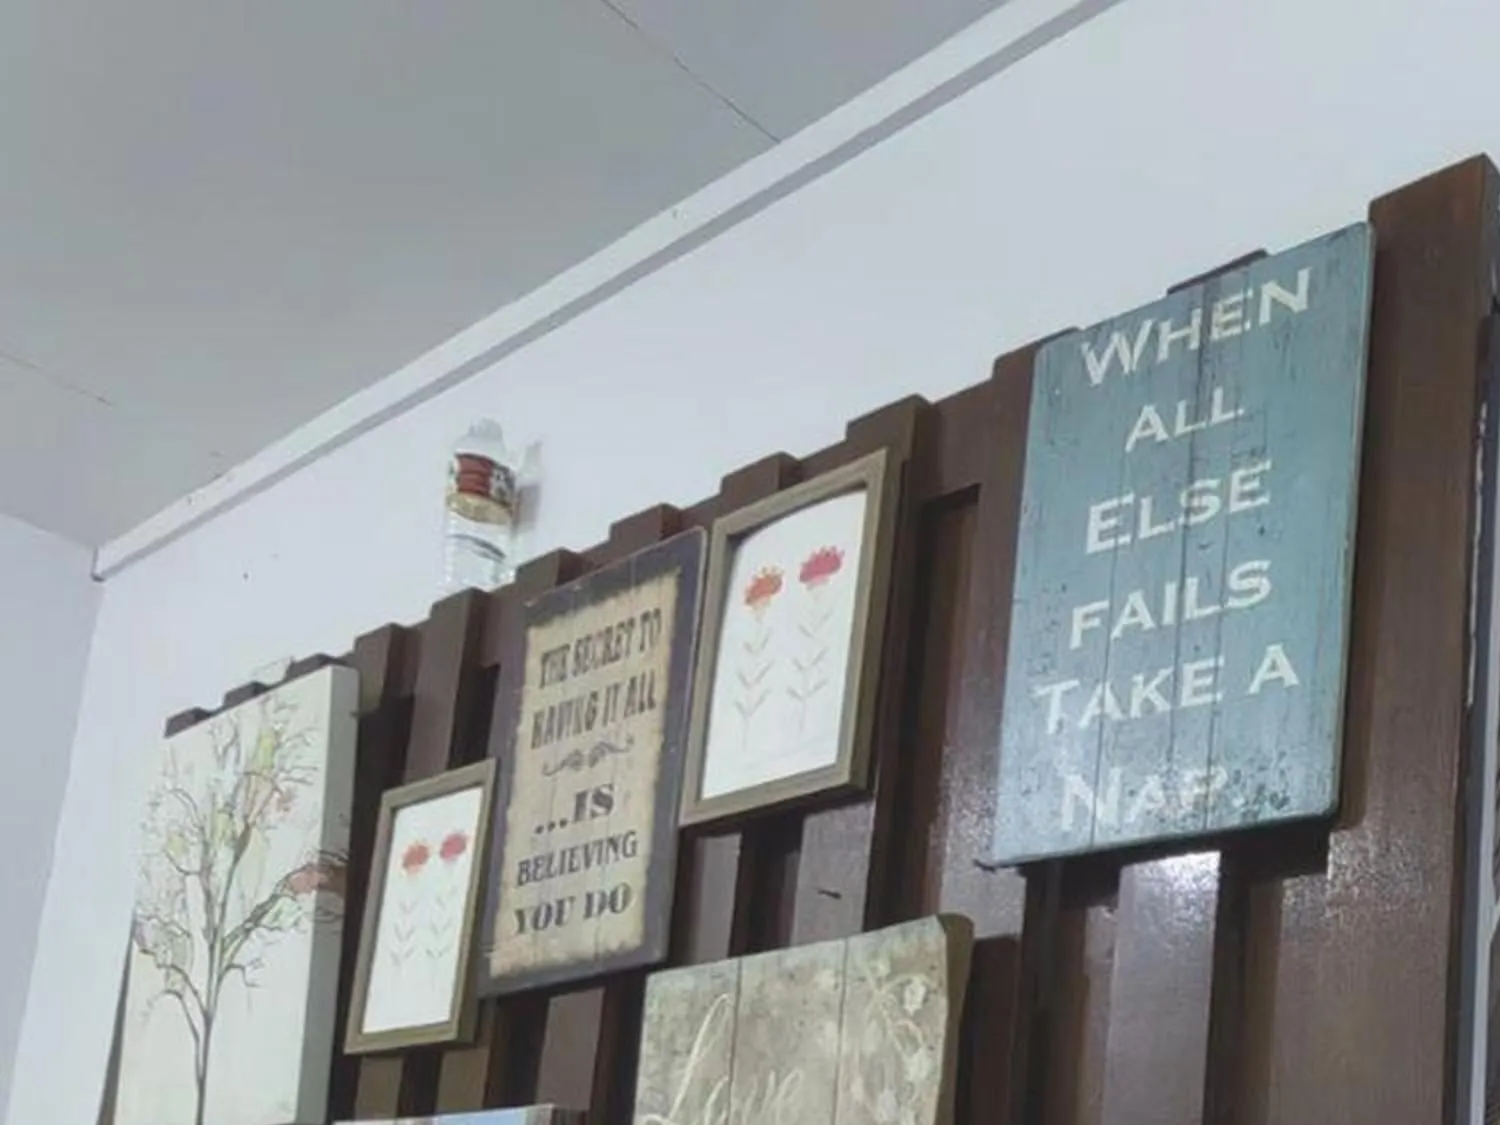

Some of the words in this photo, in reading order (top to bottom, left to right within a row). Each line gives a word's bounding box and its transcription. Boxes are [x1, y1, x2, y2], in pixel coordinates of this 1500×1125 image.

[1082, 269, 1311, 386] WHEN
[1125, 387, 1245, 451] ALL
[1086, 461, 1272, 554] ELSE
[639, 607, 662, 654] TO
[1070, 560, 1272, 650] FAILS
[624, 668, 657, 715] ALL
[1034, 656, 1225, 734] TAKE
[1247, 644, 1300, 694] A
[517, 831, 638, 887] BELIEVING
[513, 896, 576, 935] YOU
[582, 883, 632, 920] DO
